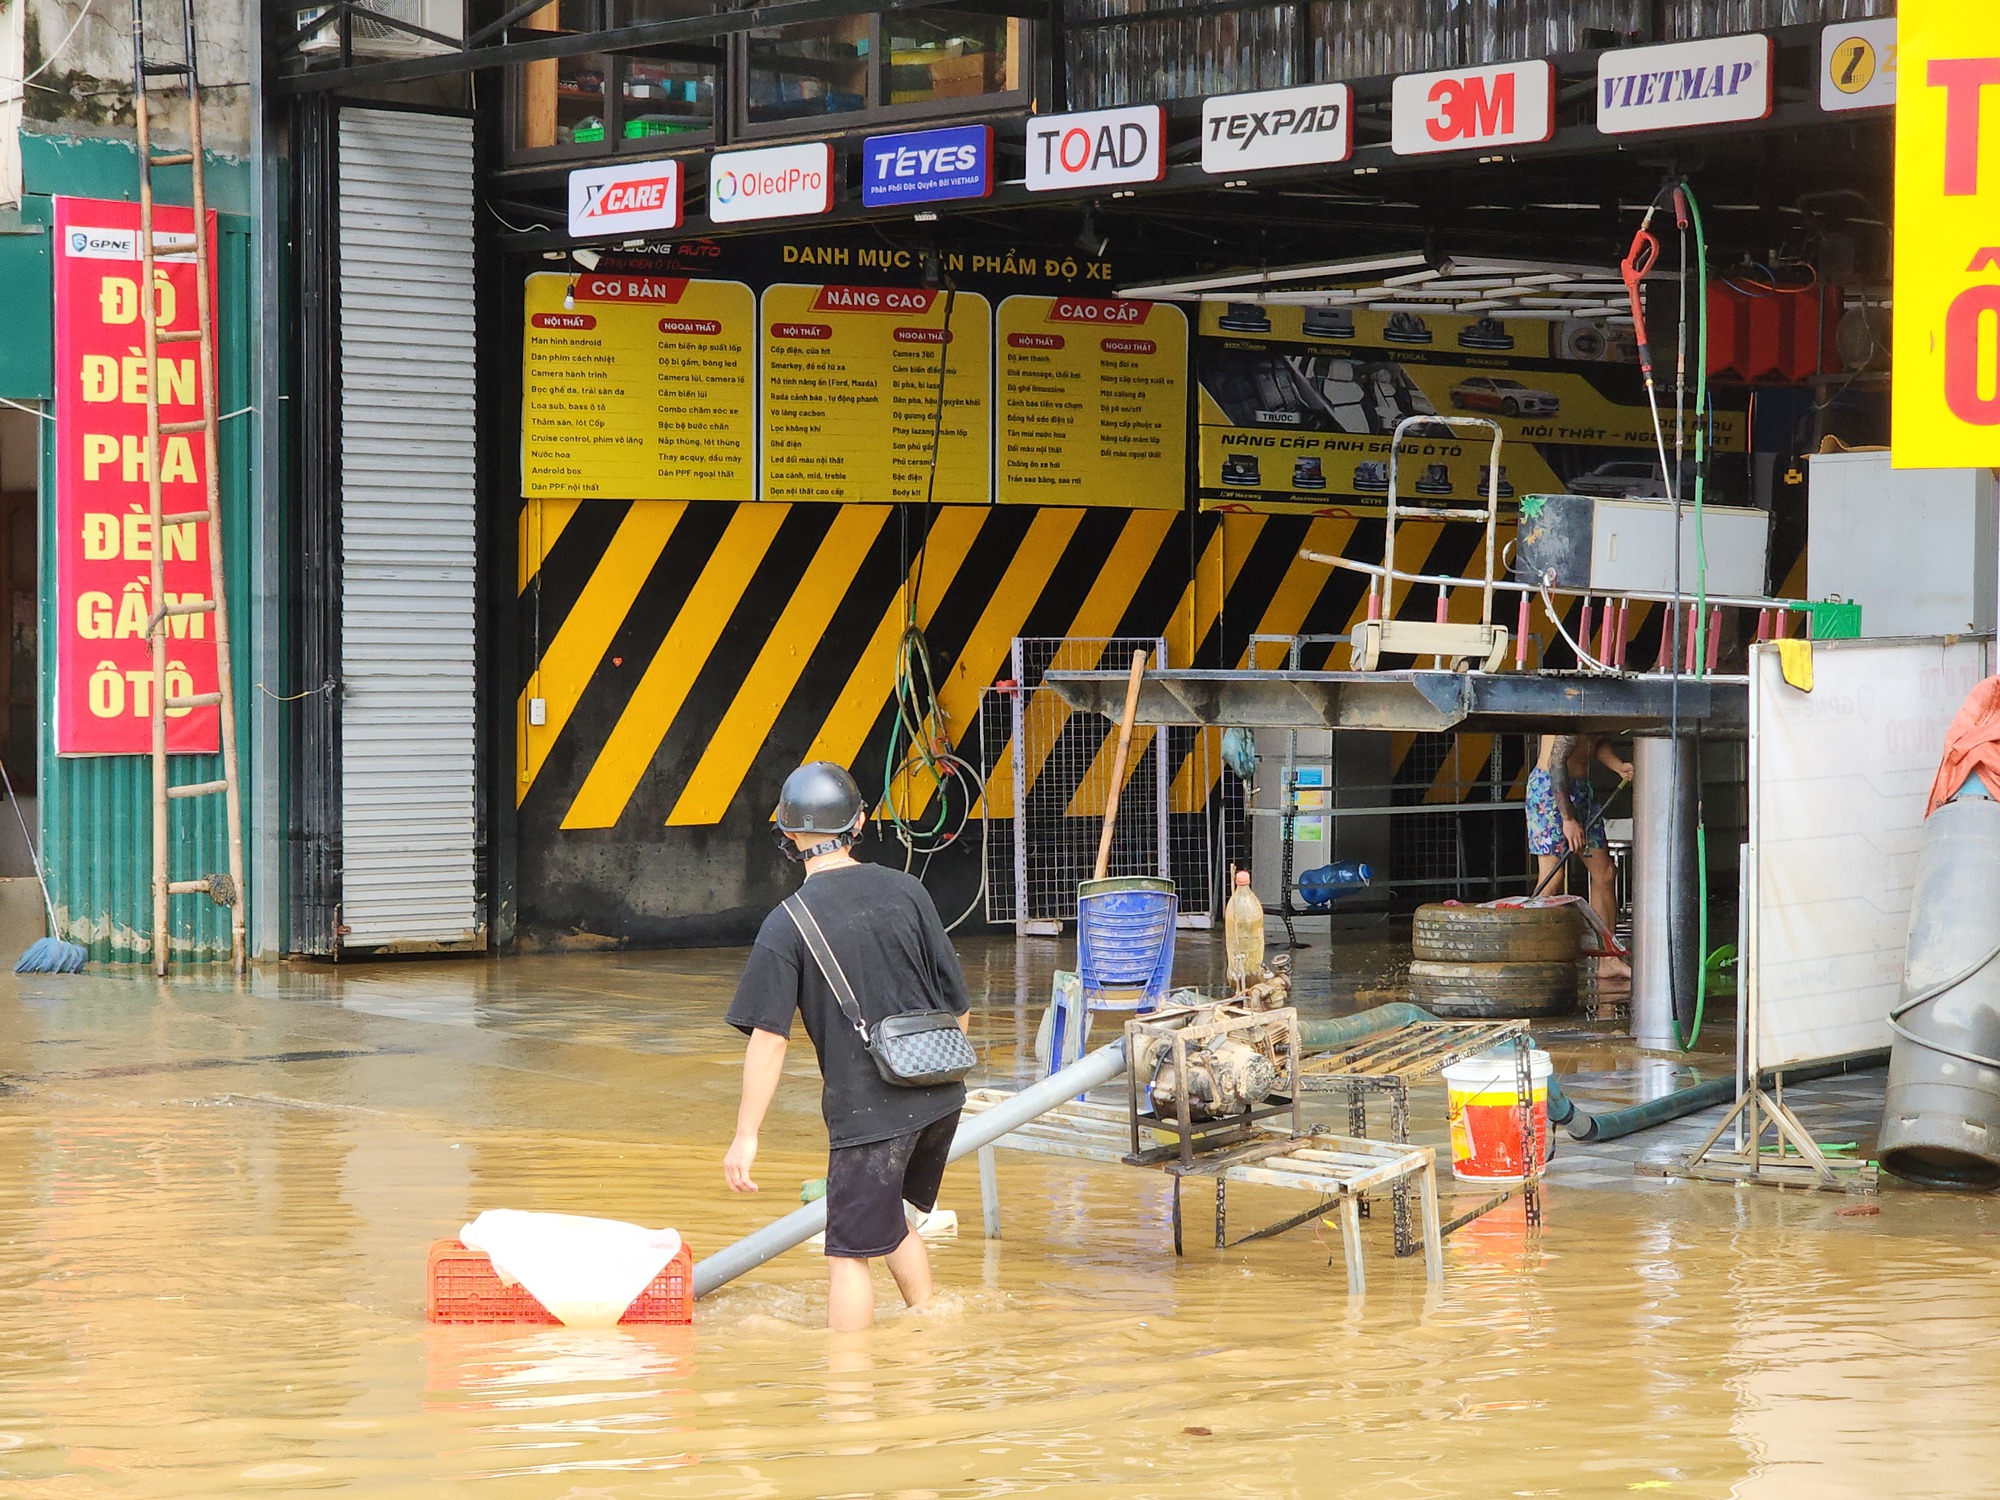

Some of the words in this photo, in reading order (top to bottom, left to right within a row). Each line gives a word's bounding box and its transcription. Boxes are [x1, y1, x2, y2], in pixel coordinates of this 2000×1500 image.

[1426, 72, 1514, 142] 3M
[1207, 104, 1339, 151] TEXPAD
[1038, 122, 1147, 175] TOAD
[742, 168, 821, 197] OledPro
[950, 175, 979, 186] VIETMAP
[90, 239, 131, 250] GPNE
[678, 244, 721, 258] AUTO
[783, 245, 849, 266] DANH
[858, 249, 911, 273] MỤC
[973, 247, 1036, 276] PHẨM
[1044, 256, 1078, 282] ĐỘ
[1086, 262, 1112, 280] XE
[591, 280, 622, 296] CƠ
[628, 278, 667, 299] BẢN
[99, 269, 176, 336] ĐỘ
[827, 288, 880, 307] NÂNG
[886, 293, 926, 308] CAO
[1059, 304, 1097, 319] CAO
[1103, 301, 1139, 320] CẤP
[543, 317, 563, 328] NỘI
[564, 316, 584, 327] THẤT
[664, 322, 693, 332] NGOẠI
[695, 321, 717, 332] THẤT
[783, 326, 799, 337] NỘI
[800, 326, 821, 337] THẤT
[899, 331, 926, 342] NGOẠI
[928, 331, 945, 341] THẤ
[1018, 337, 1034, 347] NỘI
[1106, 341, 1131, 352] NGOẠI
[80, 346, 195, 404] ĐÈN
[1221, 433, 1275, 447] NÂNG
[83, 434, 198, 484] PHA
[659, 453, 677, 462] Thay
[568, 484, 580, 492] nội
[893, 489, 910, 497] Body
[82, 503, 196, 561] ĐÈN
[76, 576, 204, 640] GẦM
